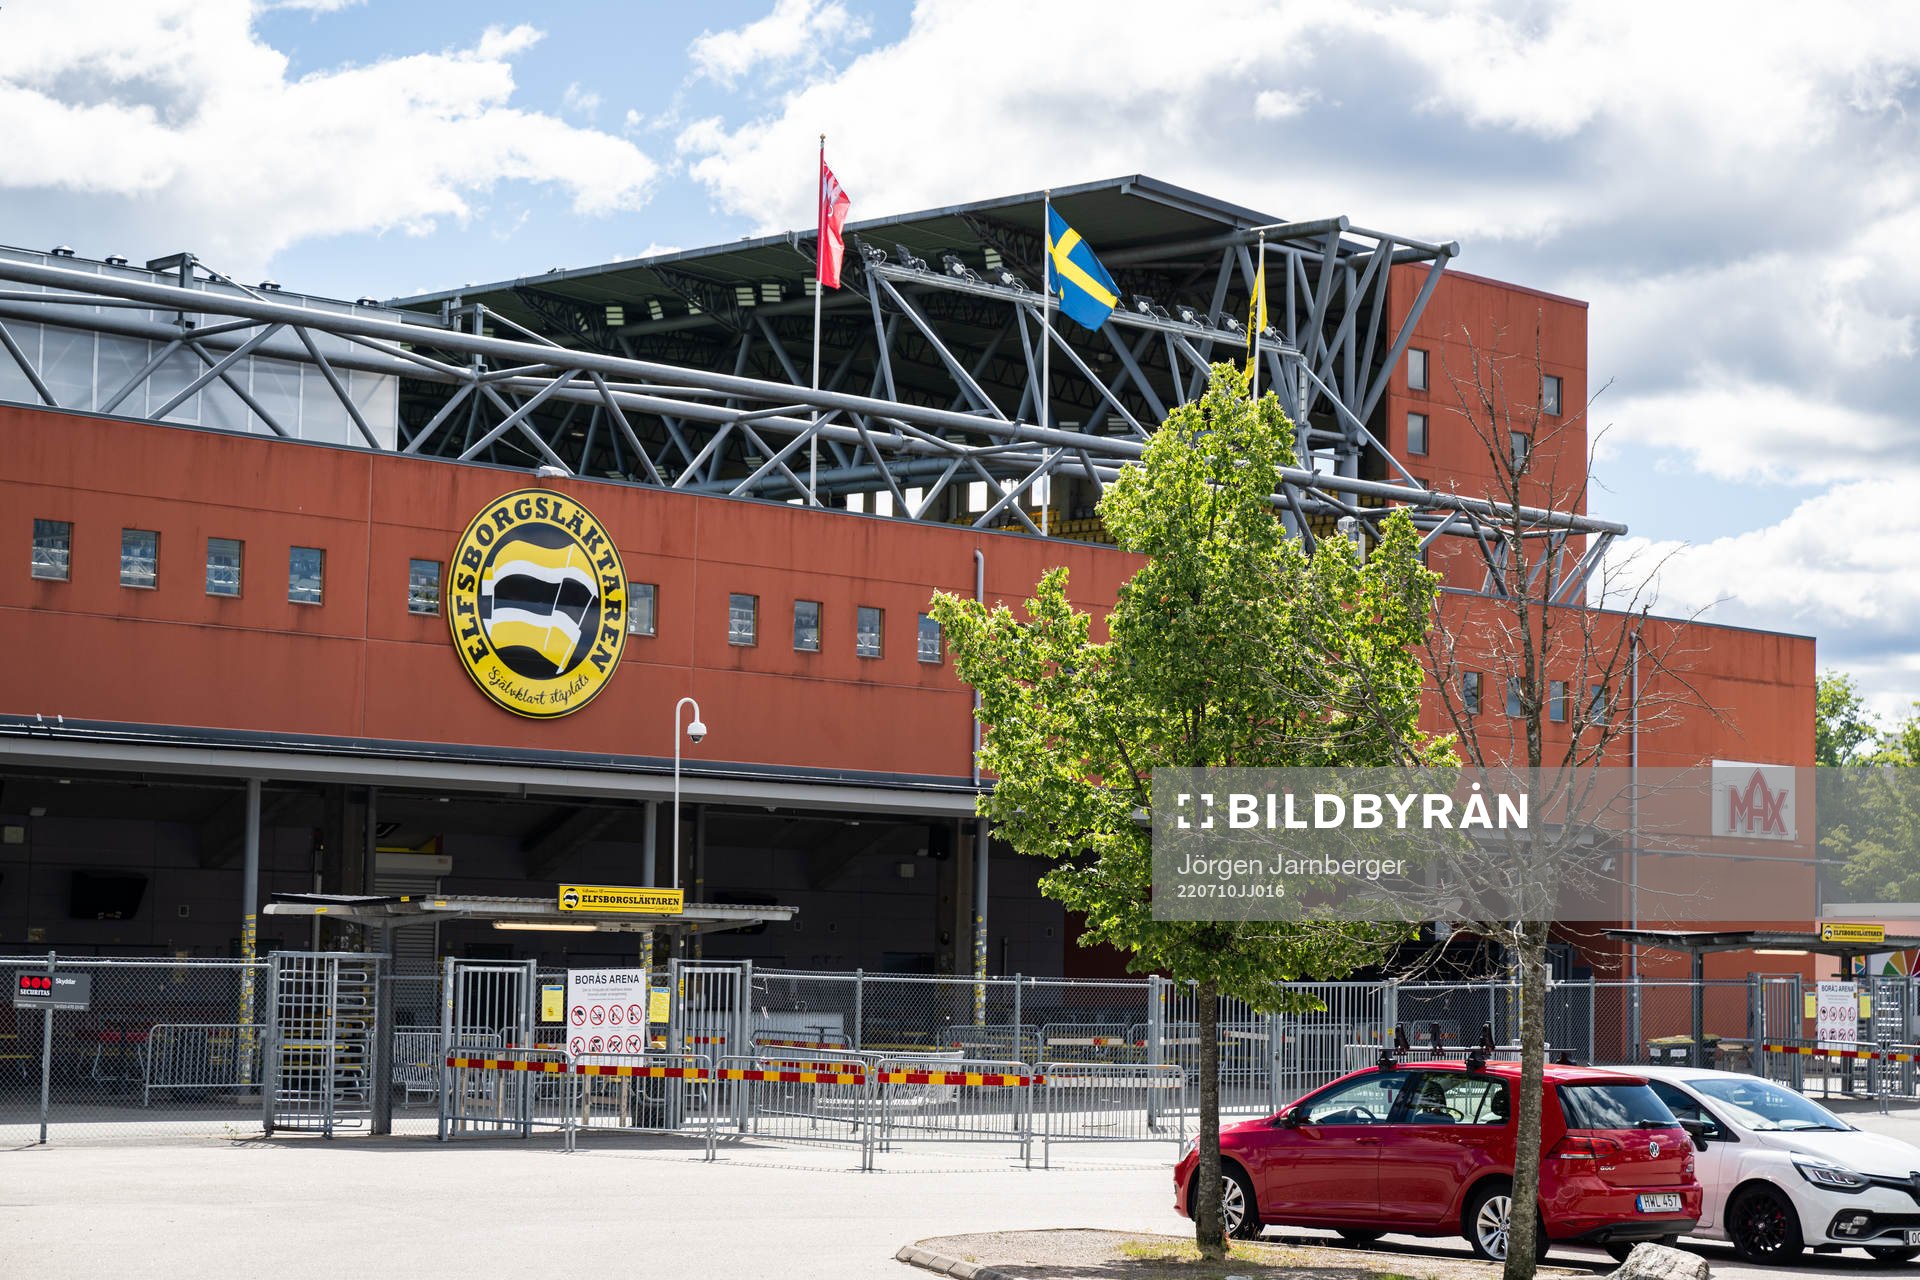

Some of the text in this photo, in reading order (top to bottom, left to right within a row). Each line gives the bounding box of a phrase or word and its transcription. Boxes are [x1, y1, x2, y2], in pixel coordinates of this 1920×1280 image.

[457, 497, 622, 673] ELFSBORGSLÄKTAREN
[488, 666, 589, 705] Självklart ståplats
[1728, 767, 1789, 835] MAX
[582, 895, 680, 906] ELFSBORGSLÄKTAREN
[575, 973, 640, 985] BORÅS ARENA
[1643, 1194, 1677, 1208] HWL 457
